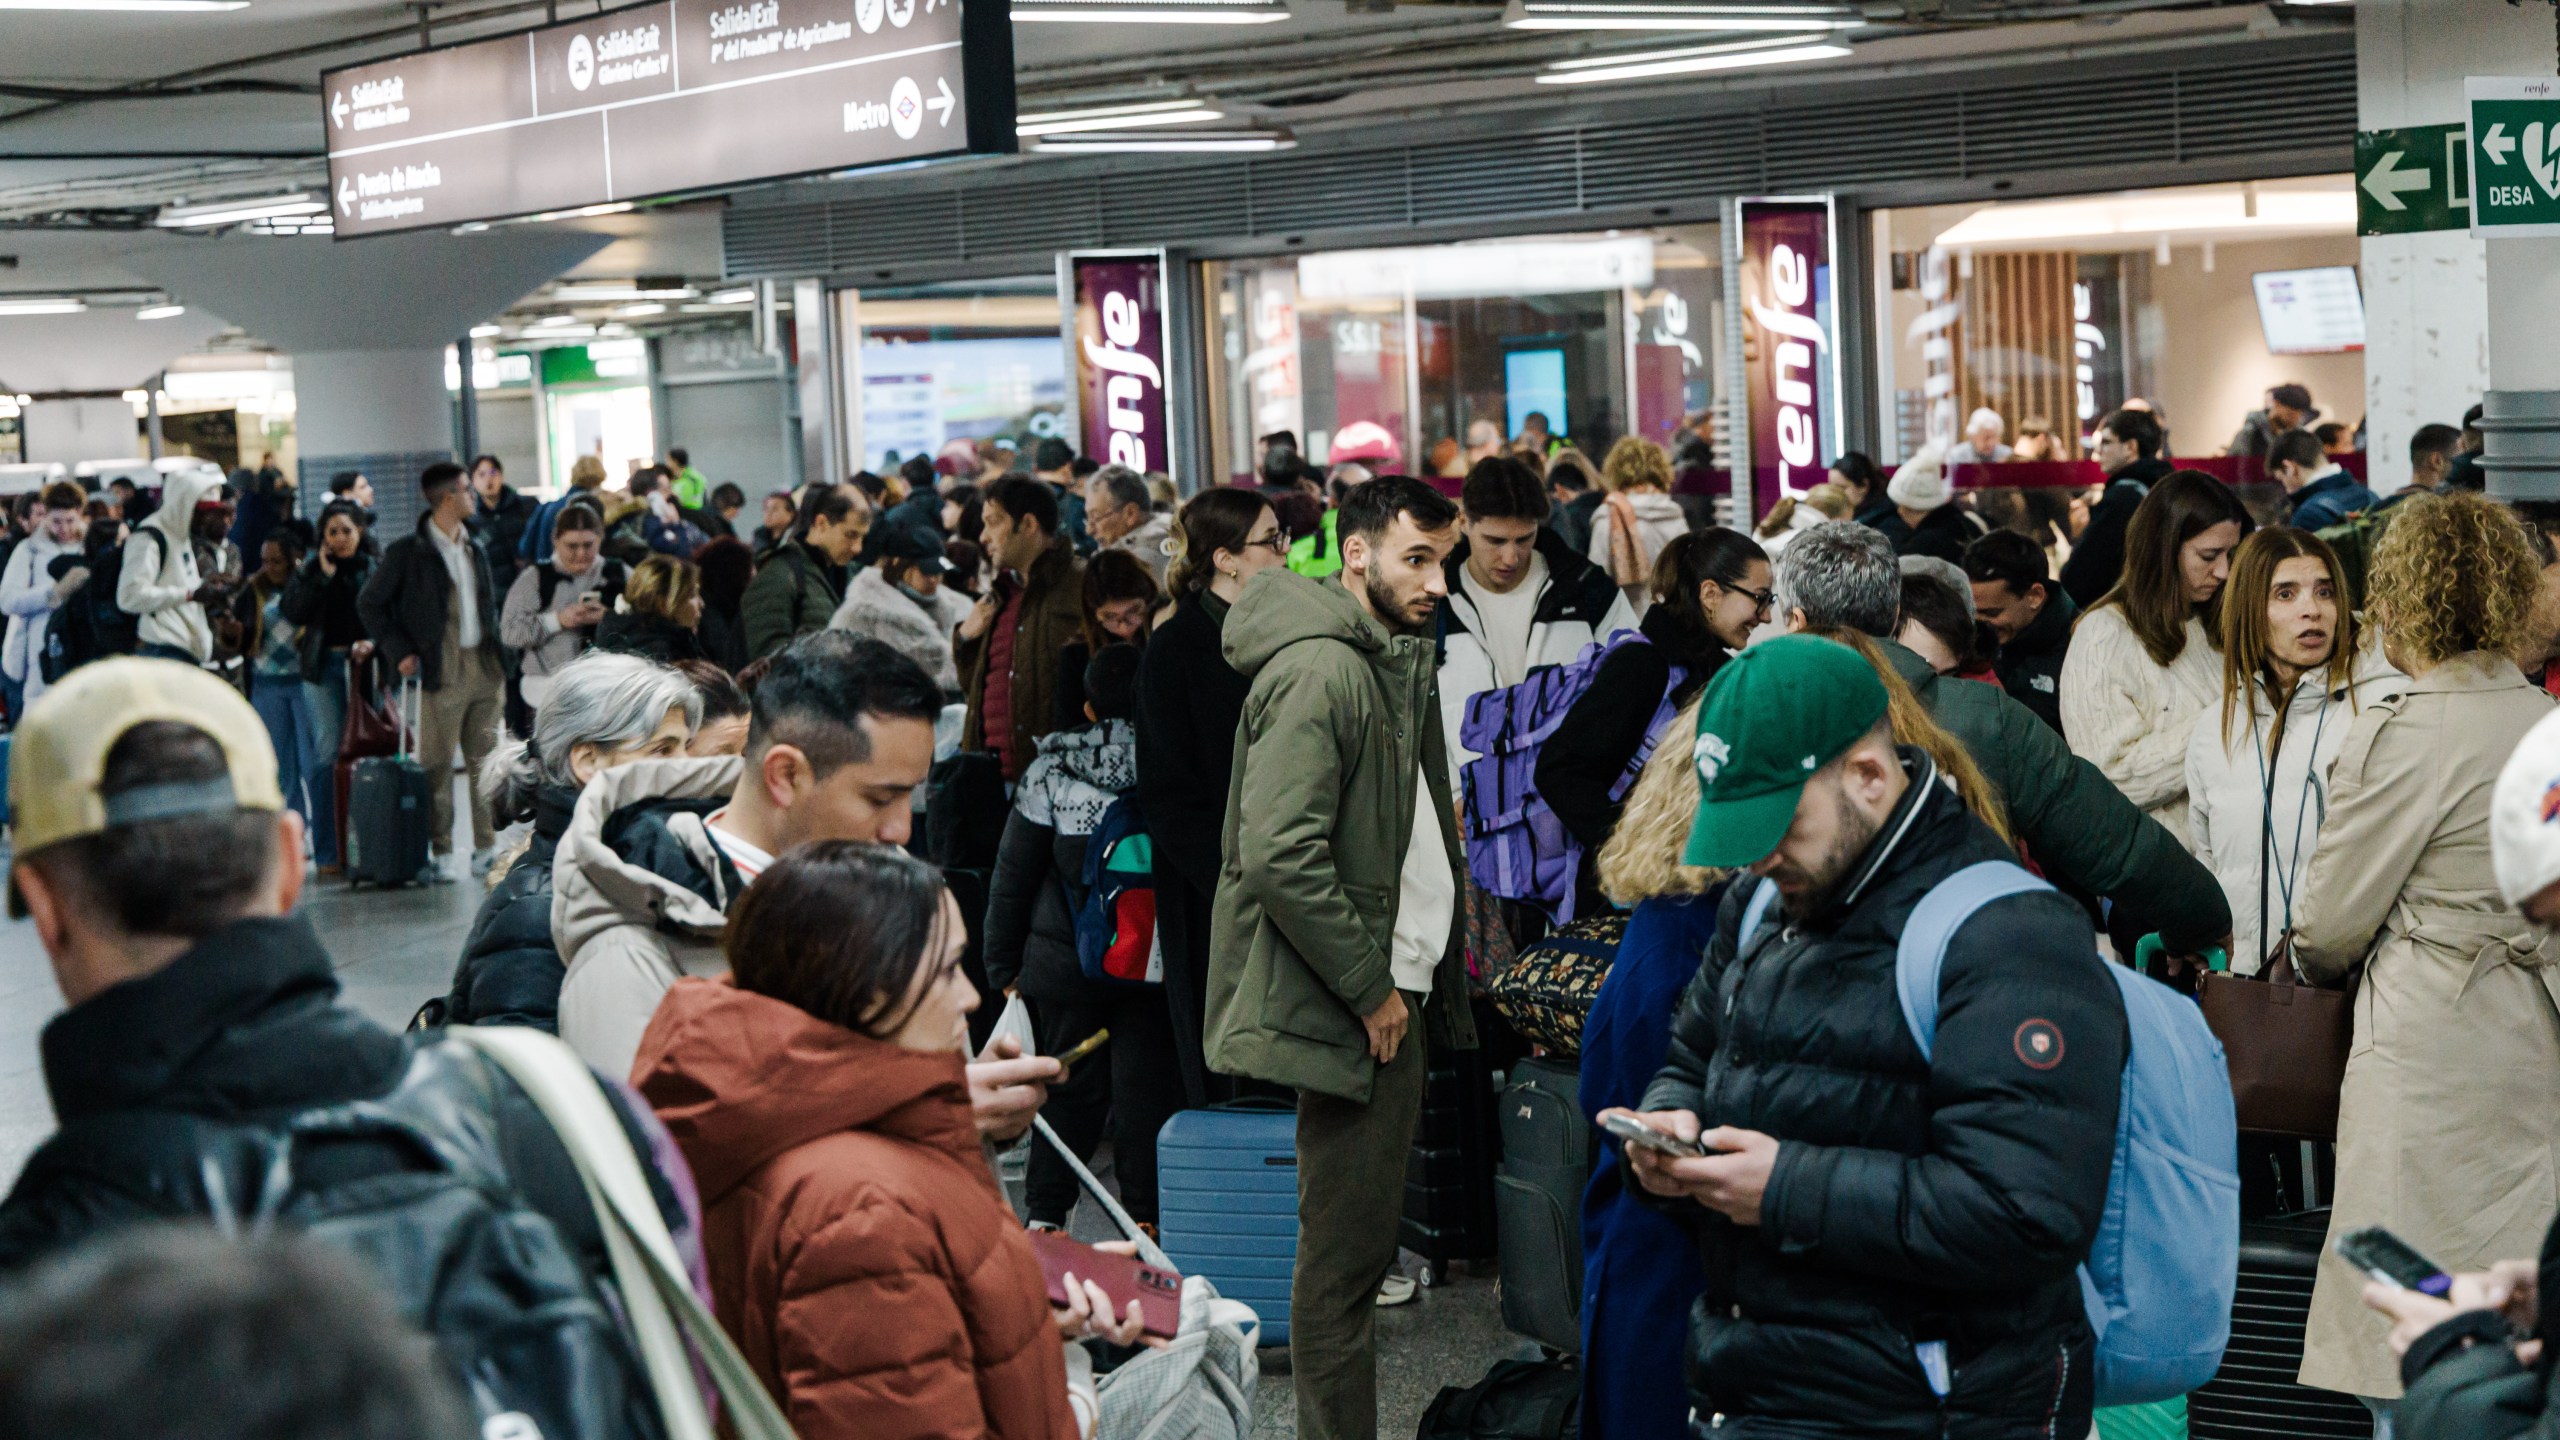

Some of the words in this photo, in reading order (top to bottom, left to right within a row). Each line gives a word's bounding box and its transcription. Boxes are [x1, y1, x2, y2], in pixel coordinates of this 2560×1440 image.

[710, 0, 779, 39] Salida/Exit
[2524, 82, 2550, 96] renfe
[843, 101, 889, 133] Metro
[2489, 185, 2534, 206] DESA
[1083, 290, 1162, 475] enfe
[1751, 243, 1828, 501] renfe
